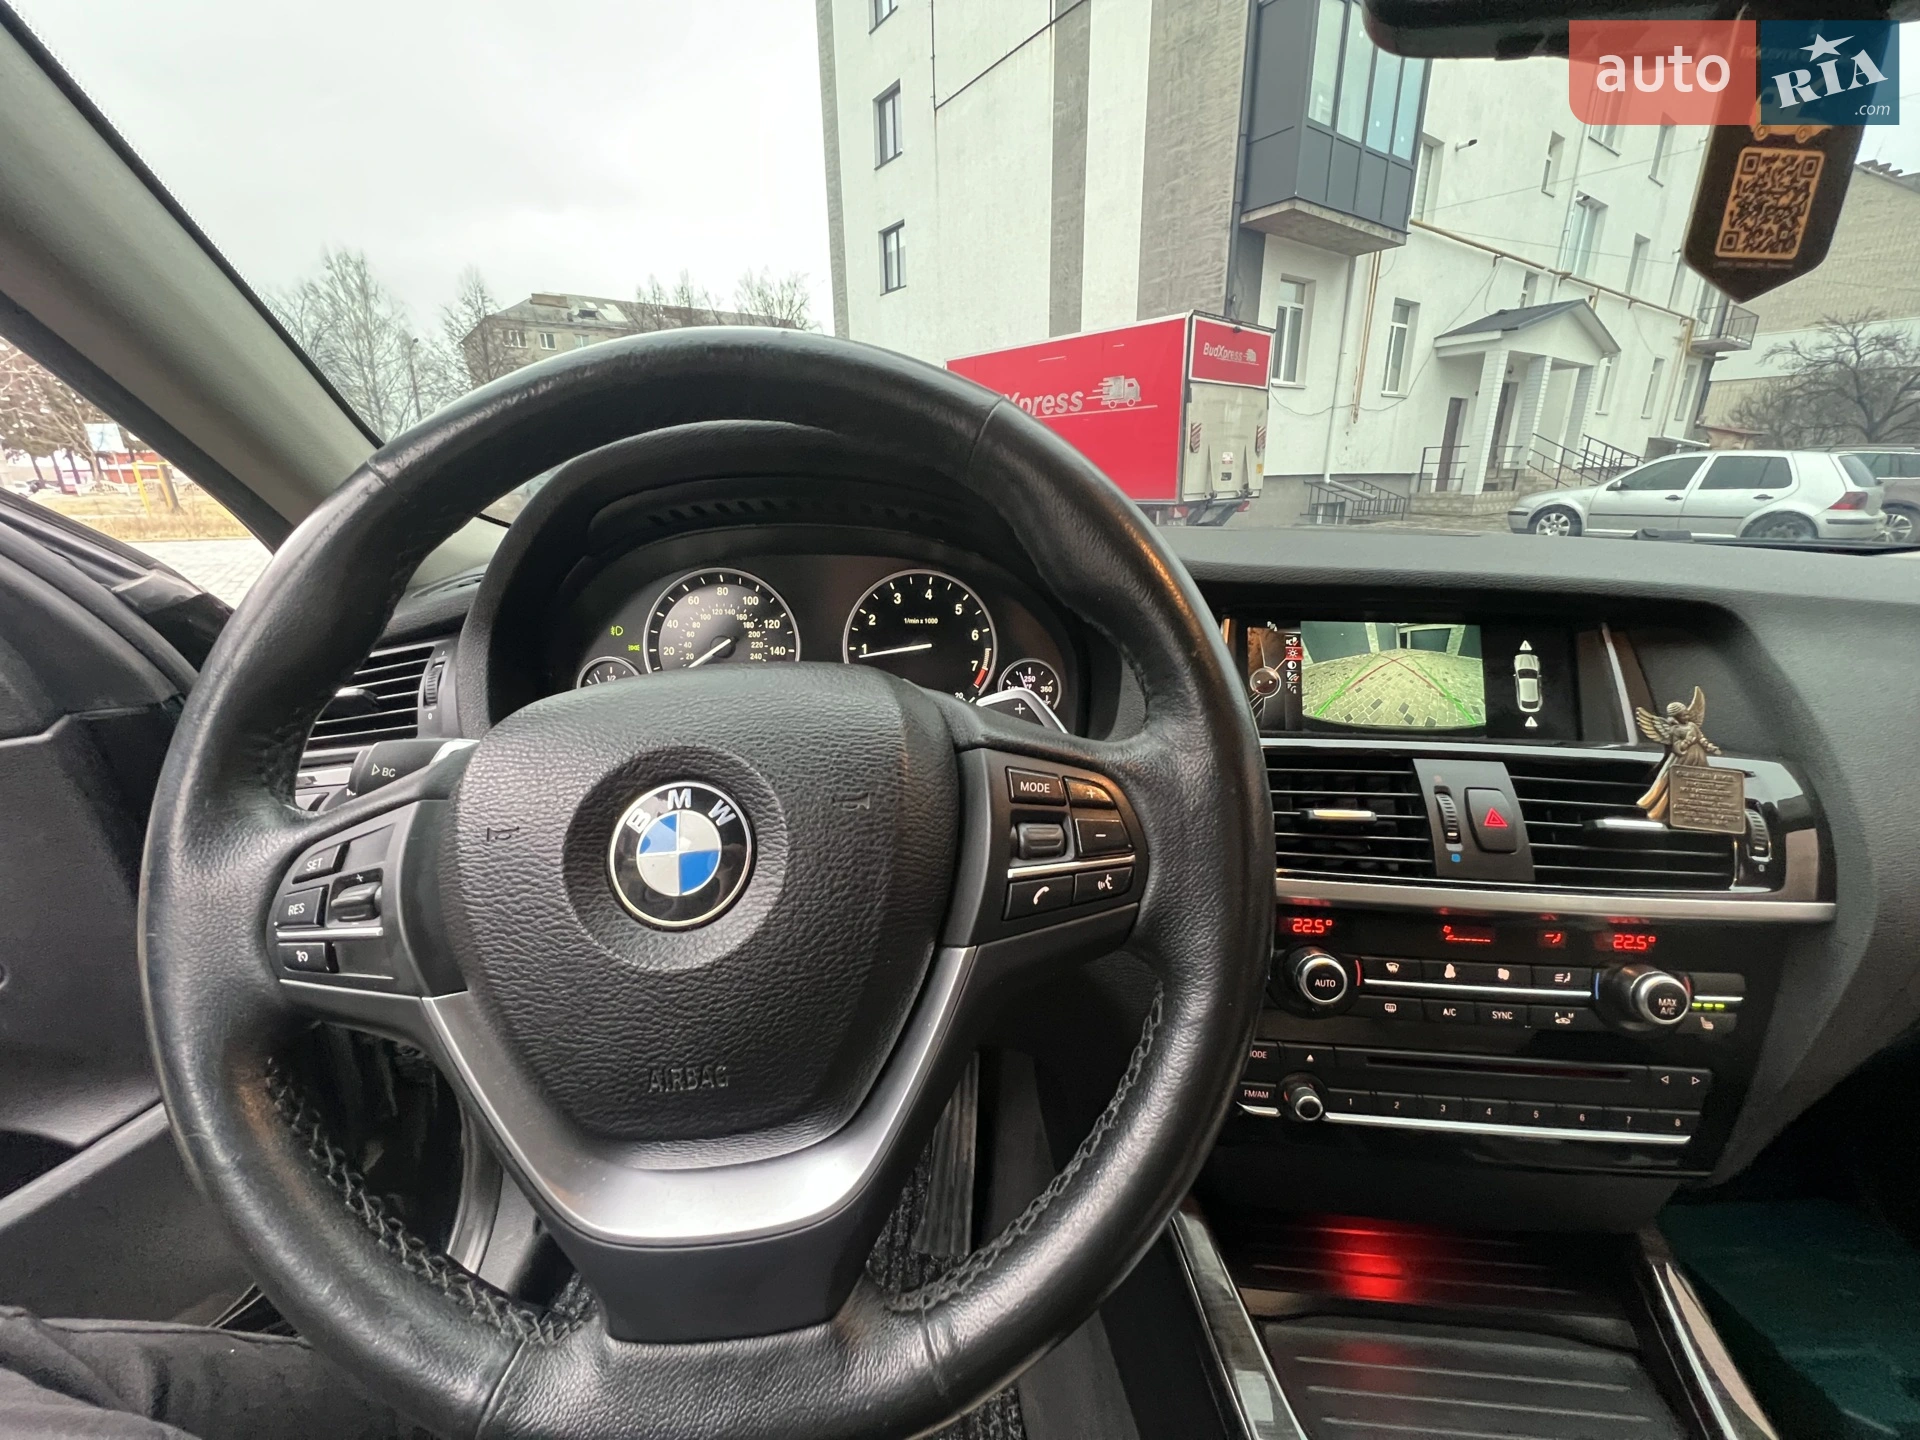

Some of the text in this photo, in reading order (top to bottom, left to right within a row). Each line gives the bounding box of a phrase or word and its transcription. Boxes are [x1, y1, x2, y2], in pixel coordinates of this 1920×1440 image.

[1203, 342, 1243, 361] BudXpress
[716, 587, 729, 596] 80
[925, 589, 933, 600] 4
[688, 596, 700, 605] 60
[742, 596, 759, 606] 100
[893, 593, 902, 605] 3
[712, 608, 723, 616] 120
[724, 608, 736, 616] 140
[955, 604, 963, 616] 5
[667, 619, 679, 629] 40
[692, 621, 701, 629] 80
[743, 621, 755, 629] 180
[764, 619, 780, 629] 120
[868, 614, 877, 626] 2
[904, 617, 920, 625] 1/min
[748, 630, 761, 638] 200
[971, 629, 980, 641] 6
[751, 640, 764, 649] 220
[861, 643, 868, 655] 1
[663, 646, 675, 656] 20
[769, 646, 786, 656] 140
[750, 653, 763, 661] 240
[970, 660, 979, 672] 7
[1023, 675, 1036, 683] 250
[381, 766, 396, 778] BC
[1020, 781, 1051, 794] MODE
[626, 788, 736, 834] BMW
[306, 857, 323, 872] SET
[288, 903, 305, 916] RES
[1314, 978, 1336, 988] AUTO
[1658, 998, 1677, 1008] MAX
[1442, 1007, 1457, 1017] A/C
[1492, 1010, 1513, 1021] SYNC
[1660, 1008, 1676, 1016] A/C
[1250, 1050, 1268, 1059] ODE
[648, 1065, 729, 1093] AIRBAG
[1244, 1089, 1269, 1099] FM/AM
